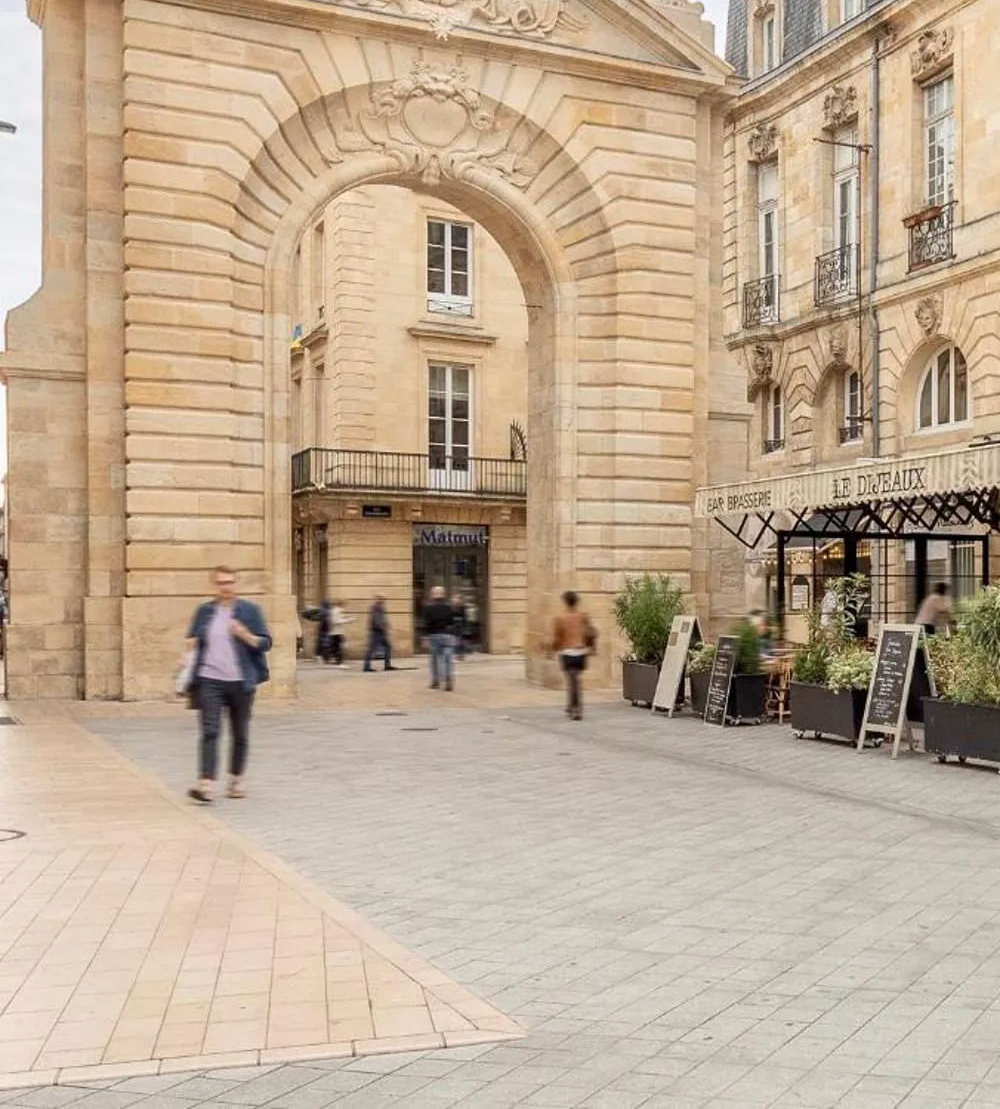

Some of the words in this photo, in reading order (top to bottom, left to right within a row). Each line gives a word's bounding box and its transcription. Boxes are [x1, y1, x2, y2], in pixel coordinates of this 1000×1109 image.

[833, 478, 850, 499] LE
[857, 467, 925, 495] DIJEAUX
[706, 497, 724, 513] BAR
[727, 490, 772, 511] BRASSERIE
[421, 530, 484, 546] Matmut
